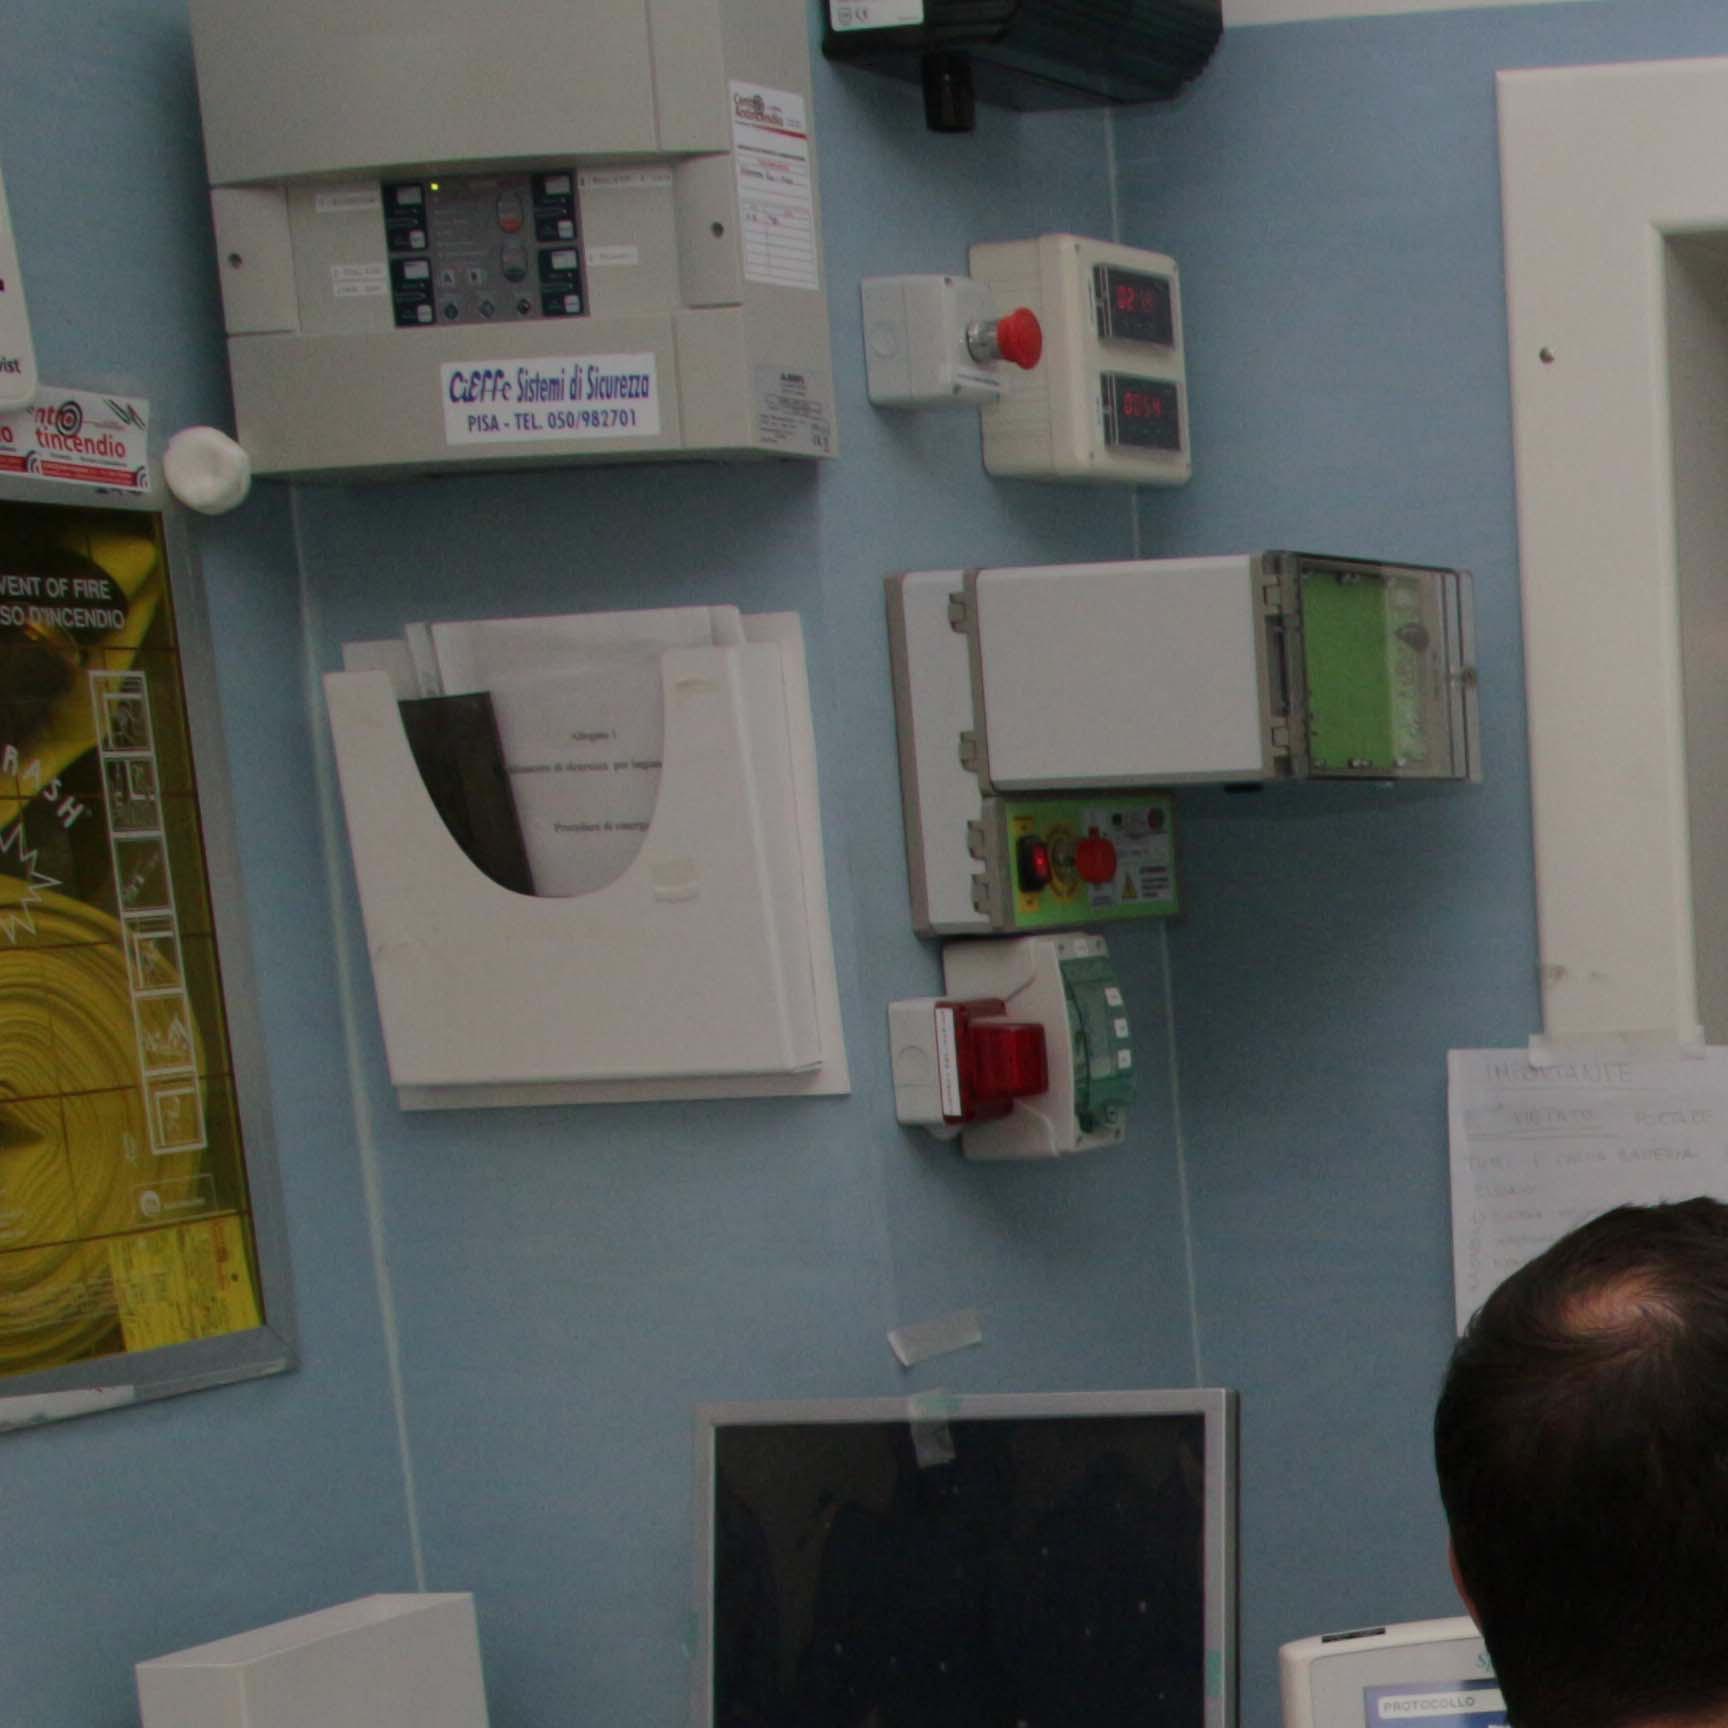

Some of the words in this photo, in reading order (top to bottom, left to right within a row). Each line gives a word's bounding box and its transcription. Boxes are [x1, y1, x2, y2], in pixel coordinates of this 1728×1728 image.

[516, 367, 566, 402] Sistemi
[569, 363, 584, 400] di
[587, 363, 650, 400] Sicurezza
[467, 414, 500, 432] PISA
[514, 411, 544, 431] TEL.
[547, 408, 637, 430] 050/982701
[46, 577, 70, 598] OF
[73, 578, 112, 600] FIRE
[30, 605, 125, 630] D'INCENDIO
[1382, 1696, 1476, 1713] PROTOCOLLO
